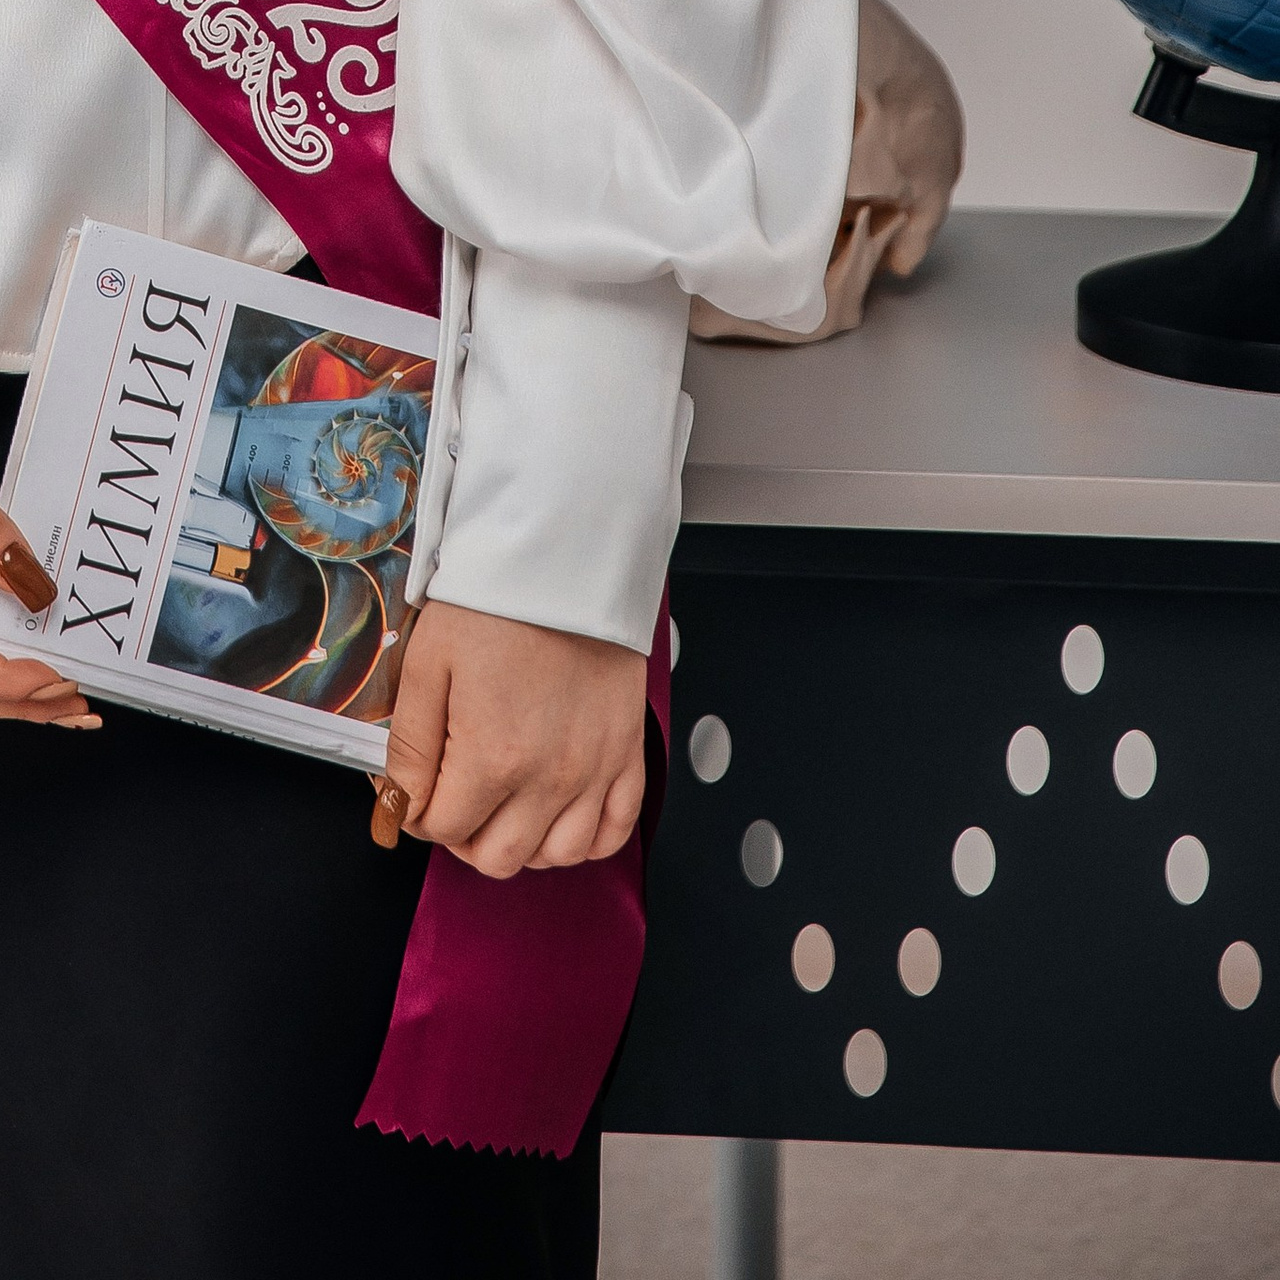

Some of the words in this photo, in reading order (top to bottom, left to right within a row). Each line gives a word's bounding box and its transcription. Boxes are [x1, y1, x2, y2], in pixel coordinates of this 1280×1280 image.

[247, 444, 259, 463] 400
[281, 453, 292, 473] 300
[59, 278, 212, 656] ХИМИЯ
